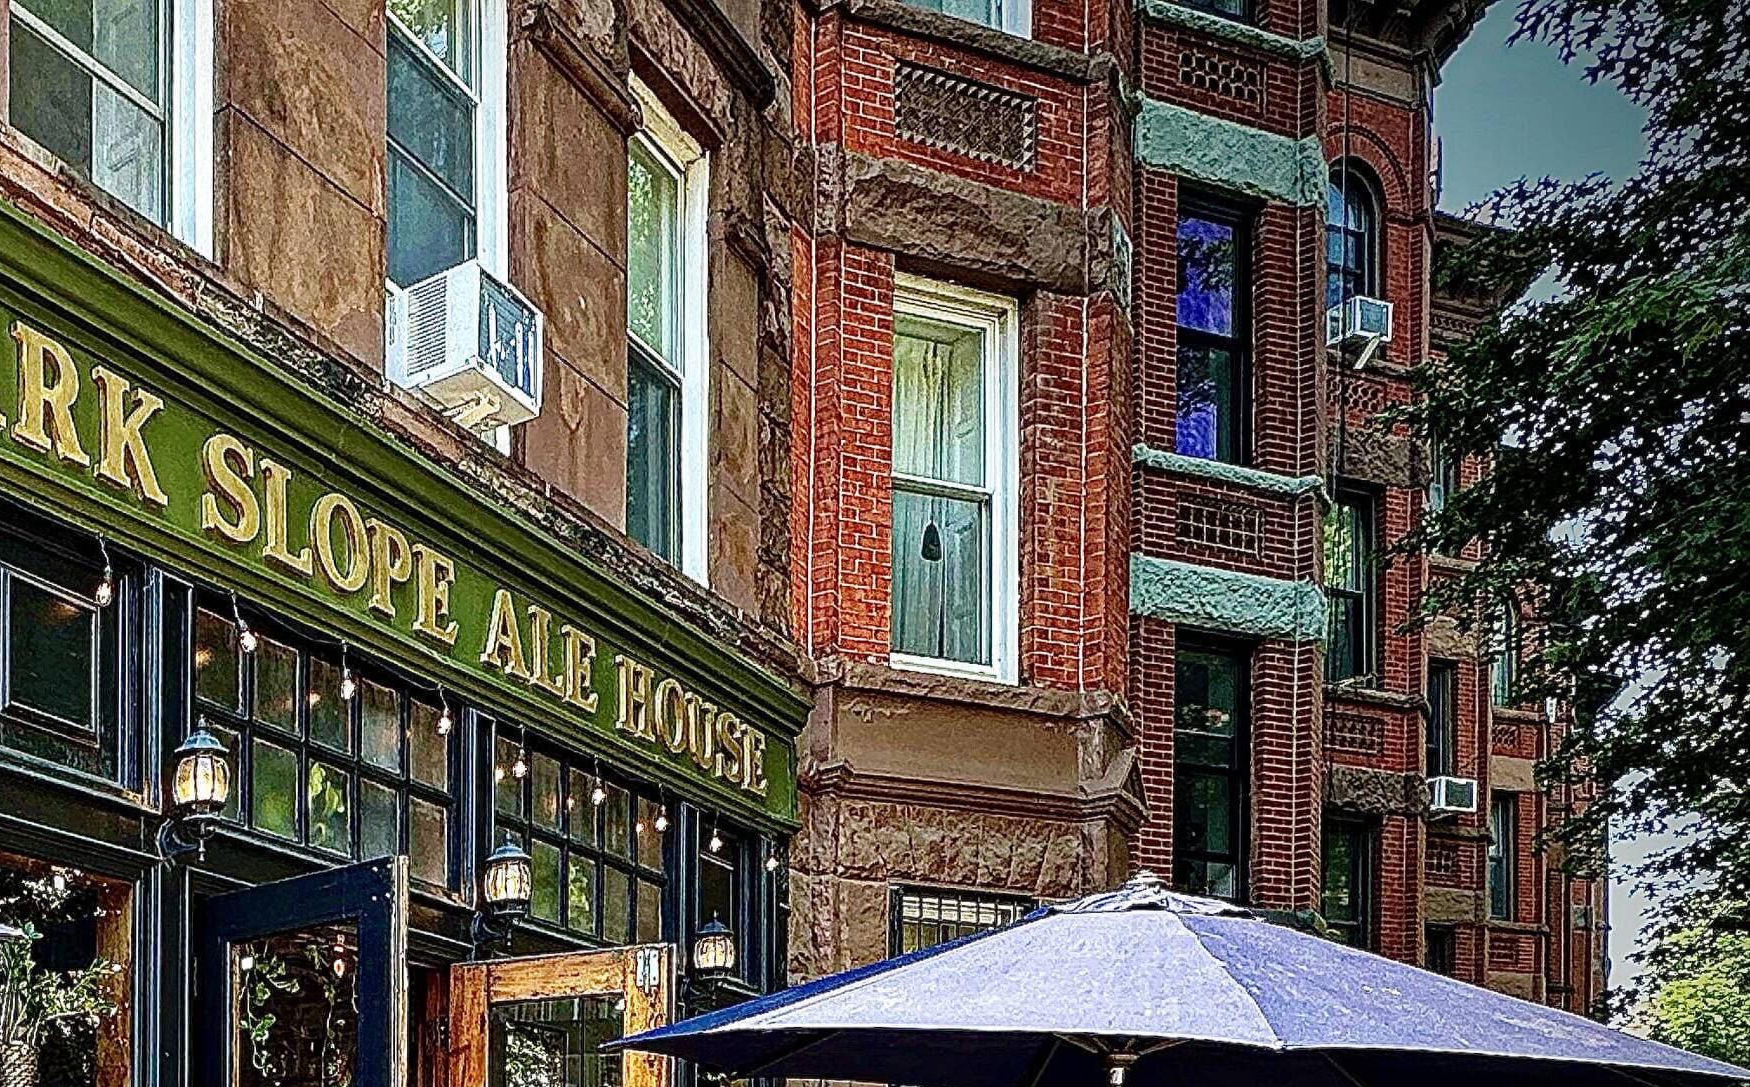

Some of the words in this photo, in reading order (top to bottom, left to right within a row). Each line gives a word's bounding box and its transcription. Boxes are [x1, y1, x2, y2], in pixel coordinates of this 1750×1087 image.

[201, 433, 458, 646] SLOPE
[480, 589, 599, 714] ALE
[614, 654, 768, 797] HOUSE
